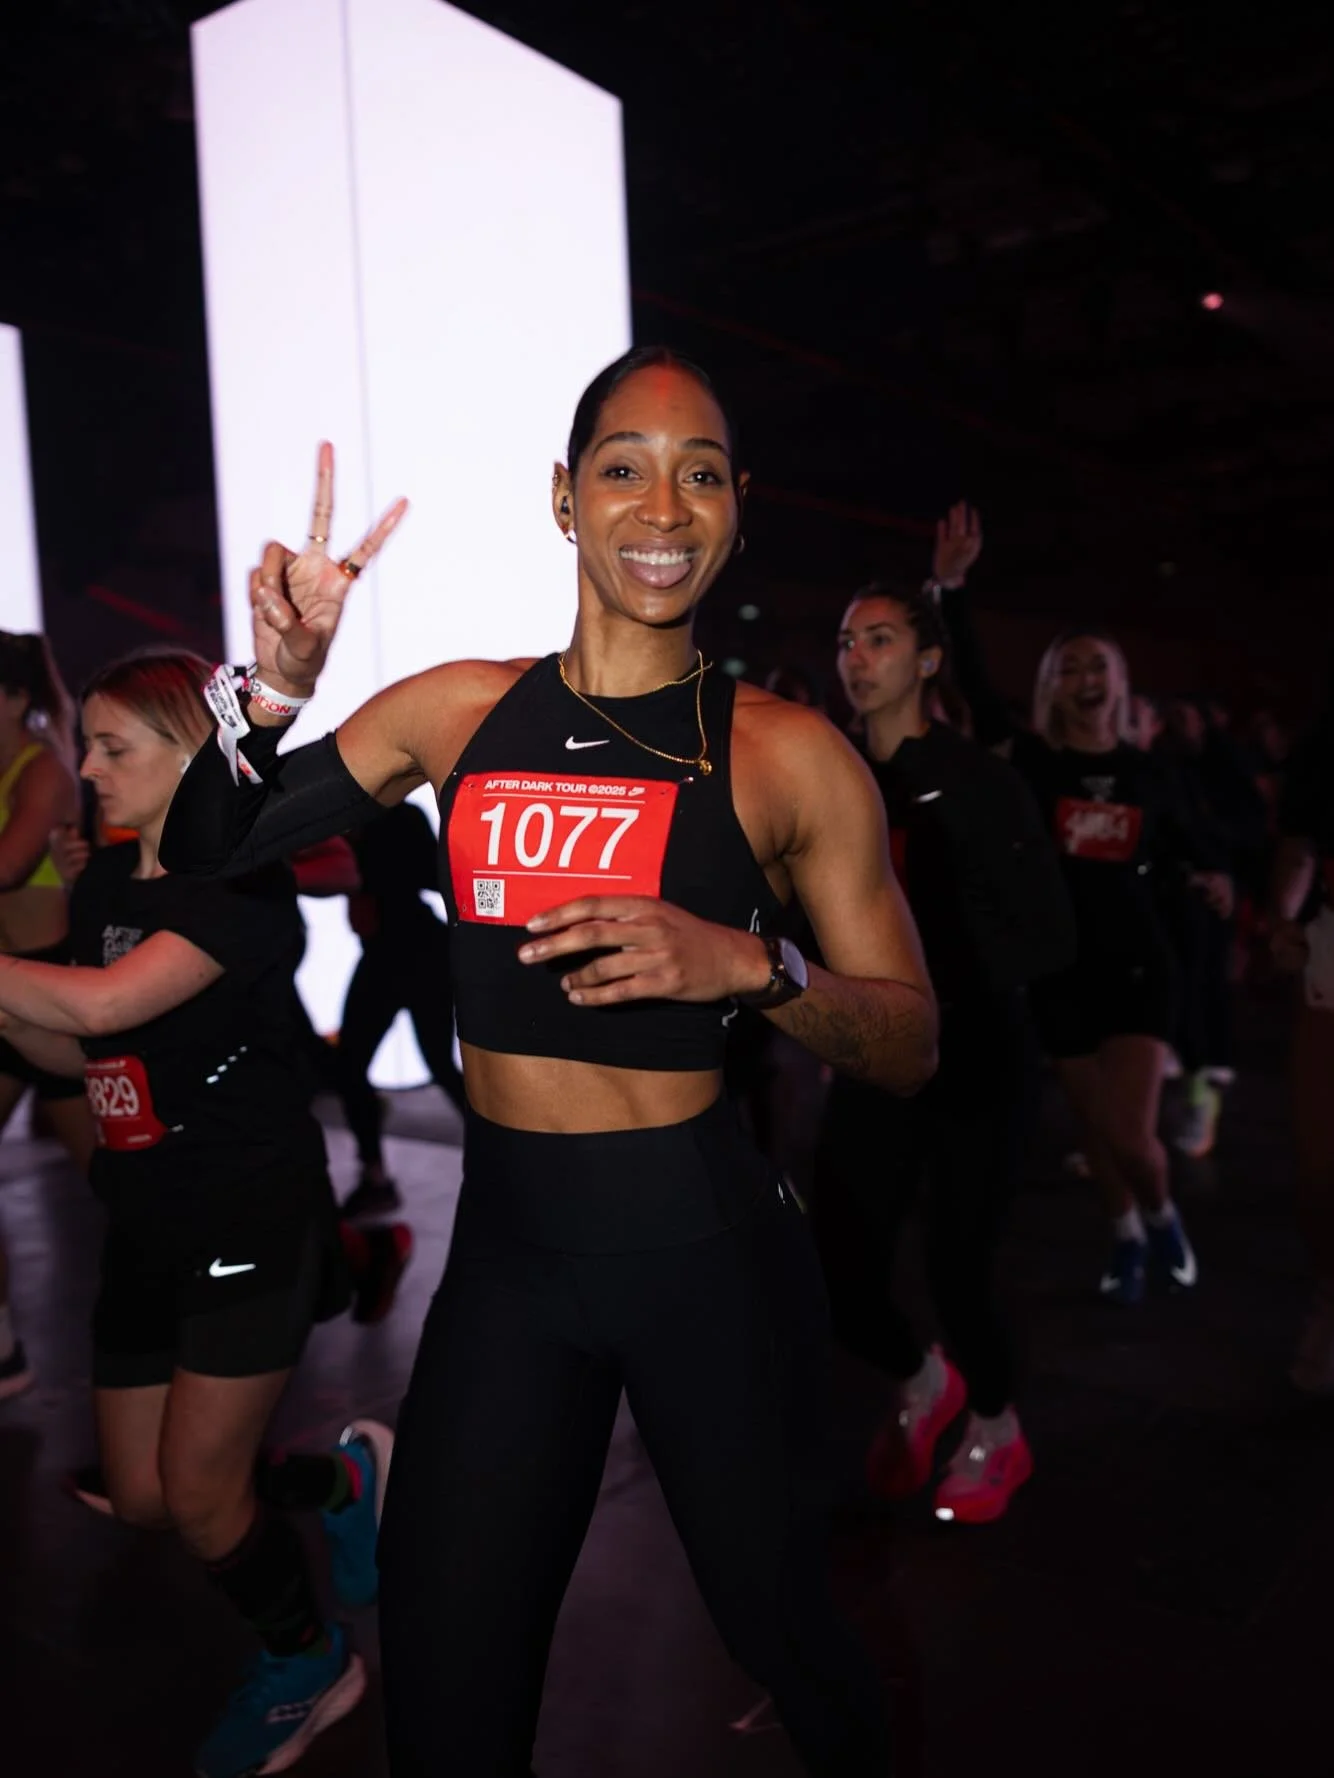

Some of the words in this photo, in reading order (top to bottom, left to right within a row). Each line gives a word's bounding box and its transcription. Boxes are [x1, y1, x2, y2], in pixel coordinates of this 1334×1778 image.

[250, 694, 291, 715] NDON
[484, 779, 521, 791] AFTER
[521, 781, 554, 792] DARK
[556, 782, 587, 794] TOUR
[480, 802, 640, 870] 1077
[84, 1075, 140, 1118] 829
